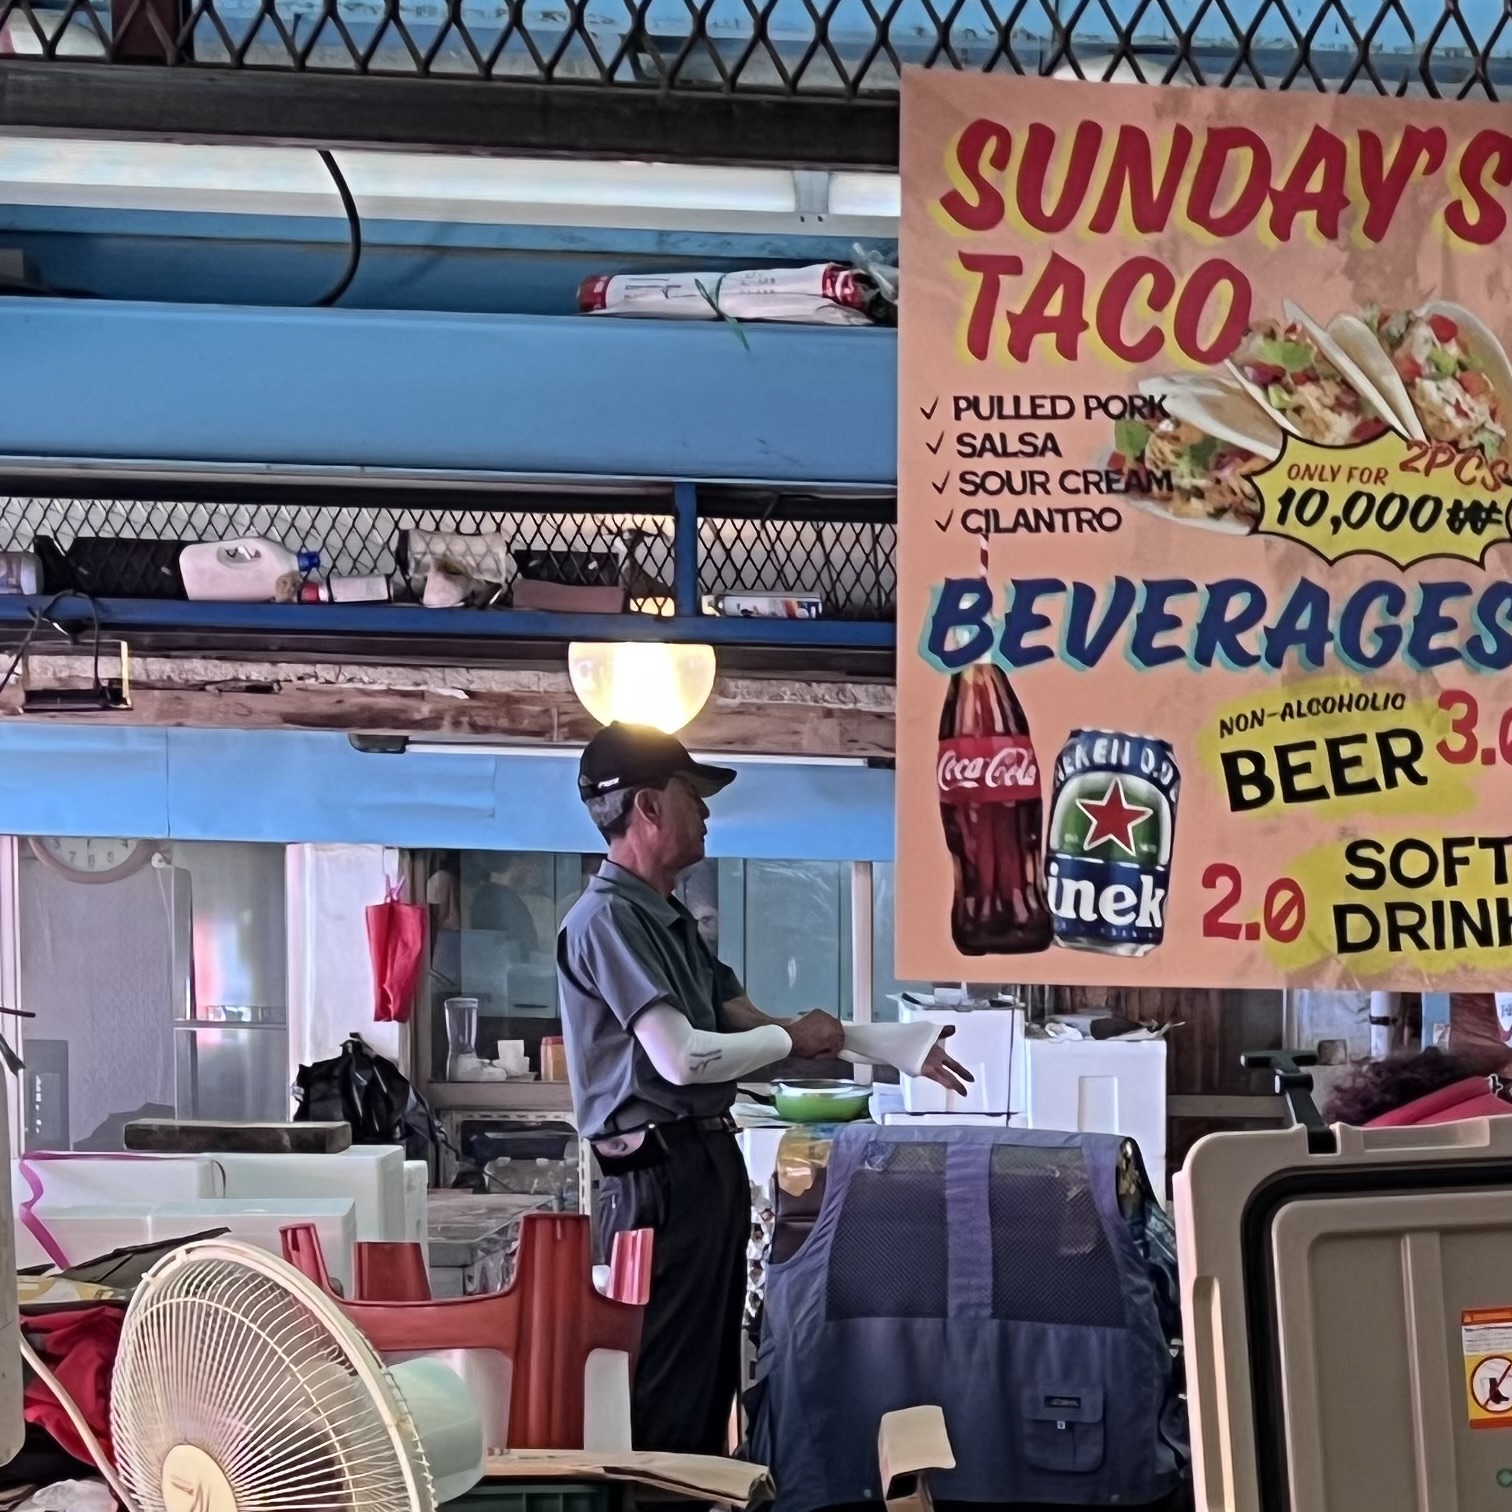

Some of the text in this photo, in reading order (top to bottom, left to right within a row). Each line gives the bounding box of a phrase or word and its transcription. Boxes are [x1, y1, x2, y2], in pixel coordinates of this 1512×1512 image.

[957, 250, 1253, 365] TACO
[953, 394, 1169, 421] PULLED PORK
[956, 431, 1062, 458] SALSA
[1287, 440, 1509, 492] ONLY FOR 2PCS
[958, 471, 1173, 496] SOUR CREAM
[960, 507, 1122, 535] CILANTRO
[1218, 693, 1406, 738] NON-ALCOHOLIC
[1220, 728, 1428, 812] BEER
[1201, 862, 1306, 944] 2.0
